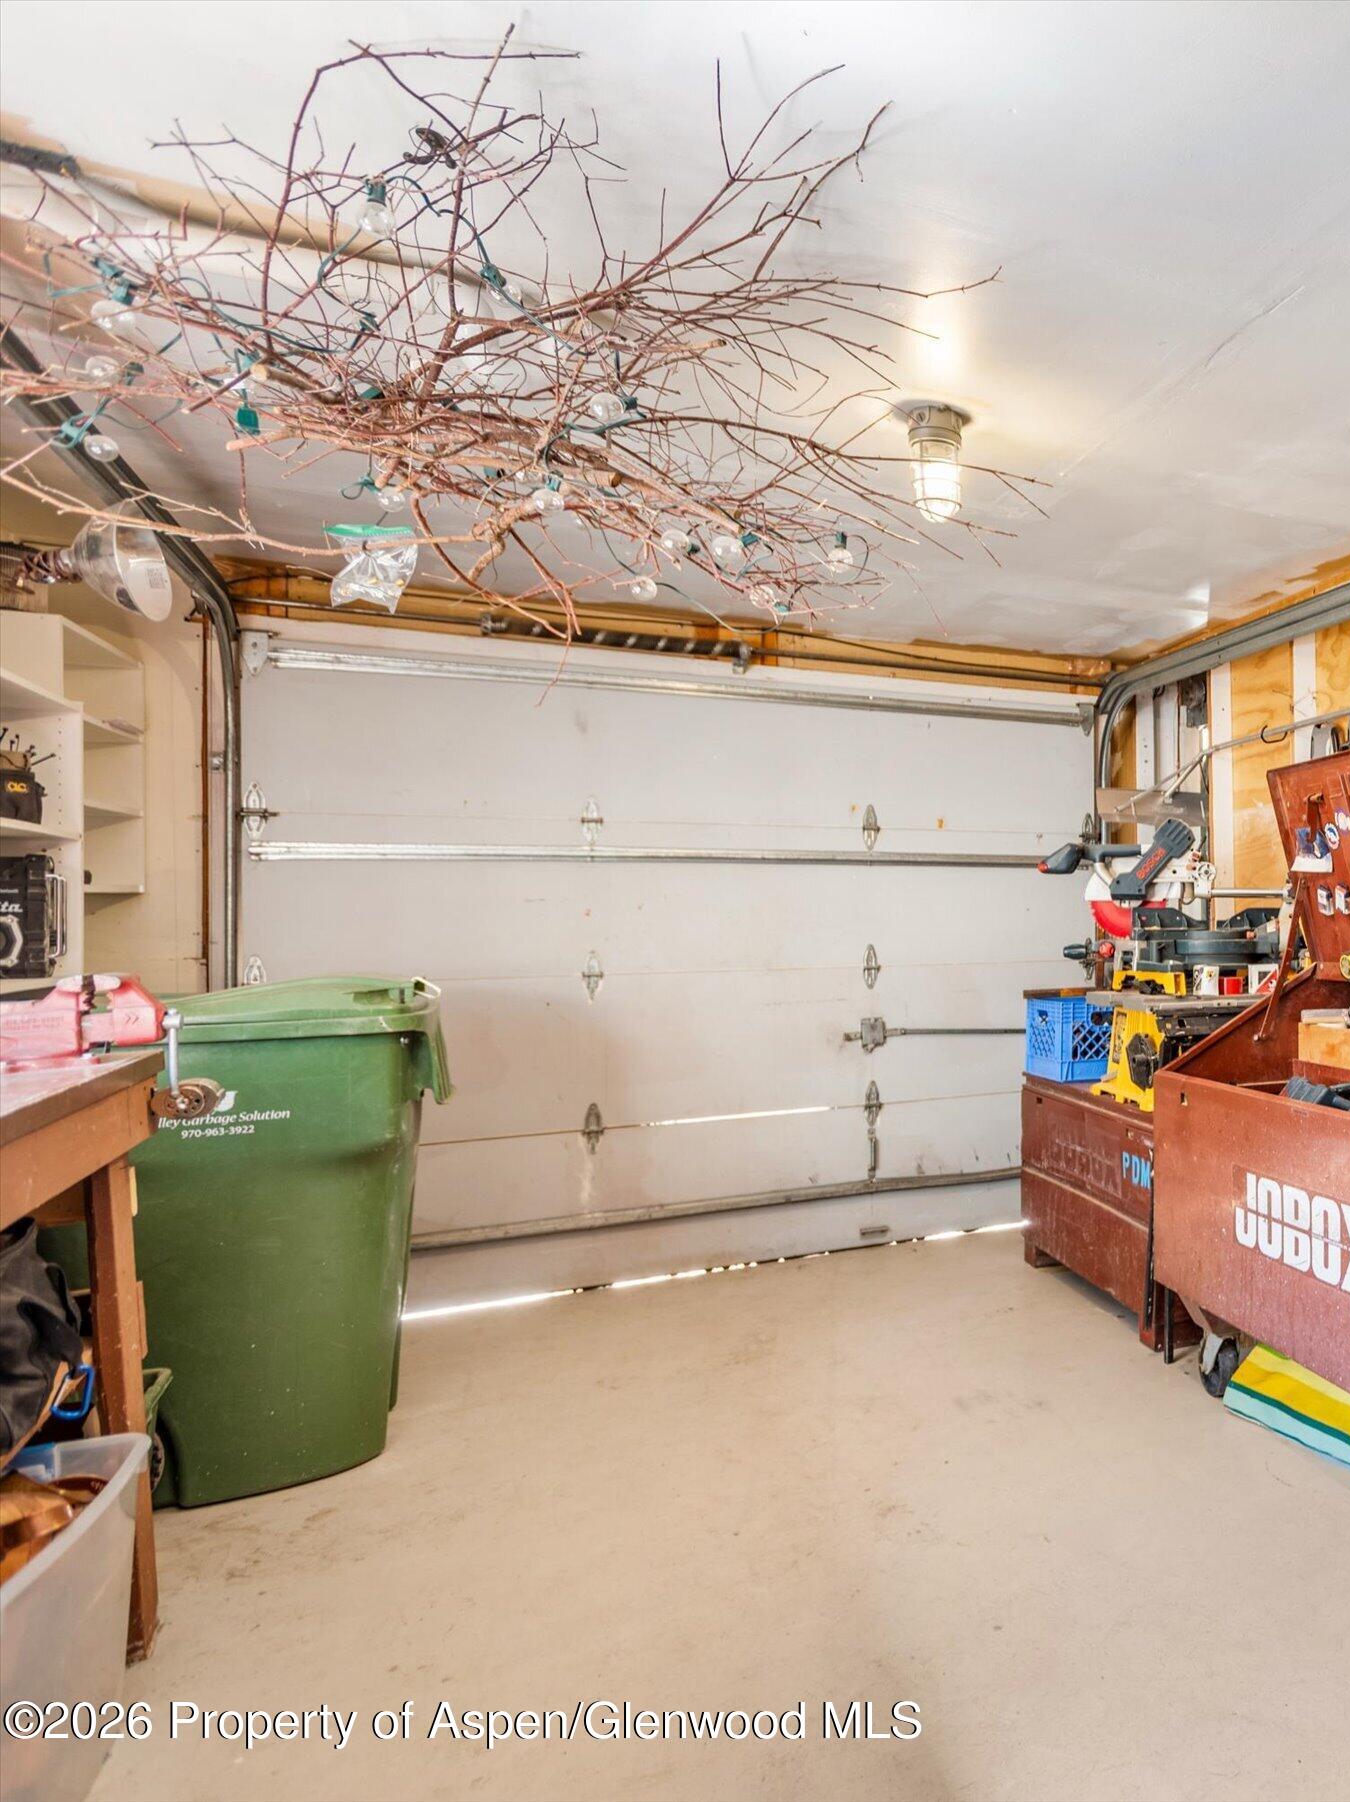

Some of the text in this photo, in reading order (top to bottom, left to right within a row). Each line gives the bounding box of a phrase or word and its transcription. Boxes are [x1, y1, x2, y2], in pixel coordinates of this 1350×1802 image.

[157, 1117, 181, 1129] lley
[238, 1109, 291, 1122] Solution
[181, 1124, 256, 1139] 970-963-3922
[1122, 1151, 1151, 1190] PDM
